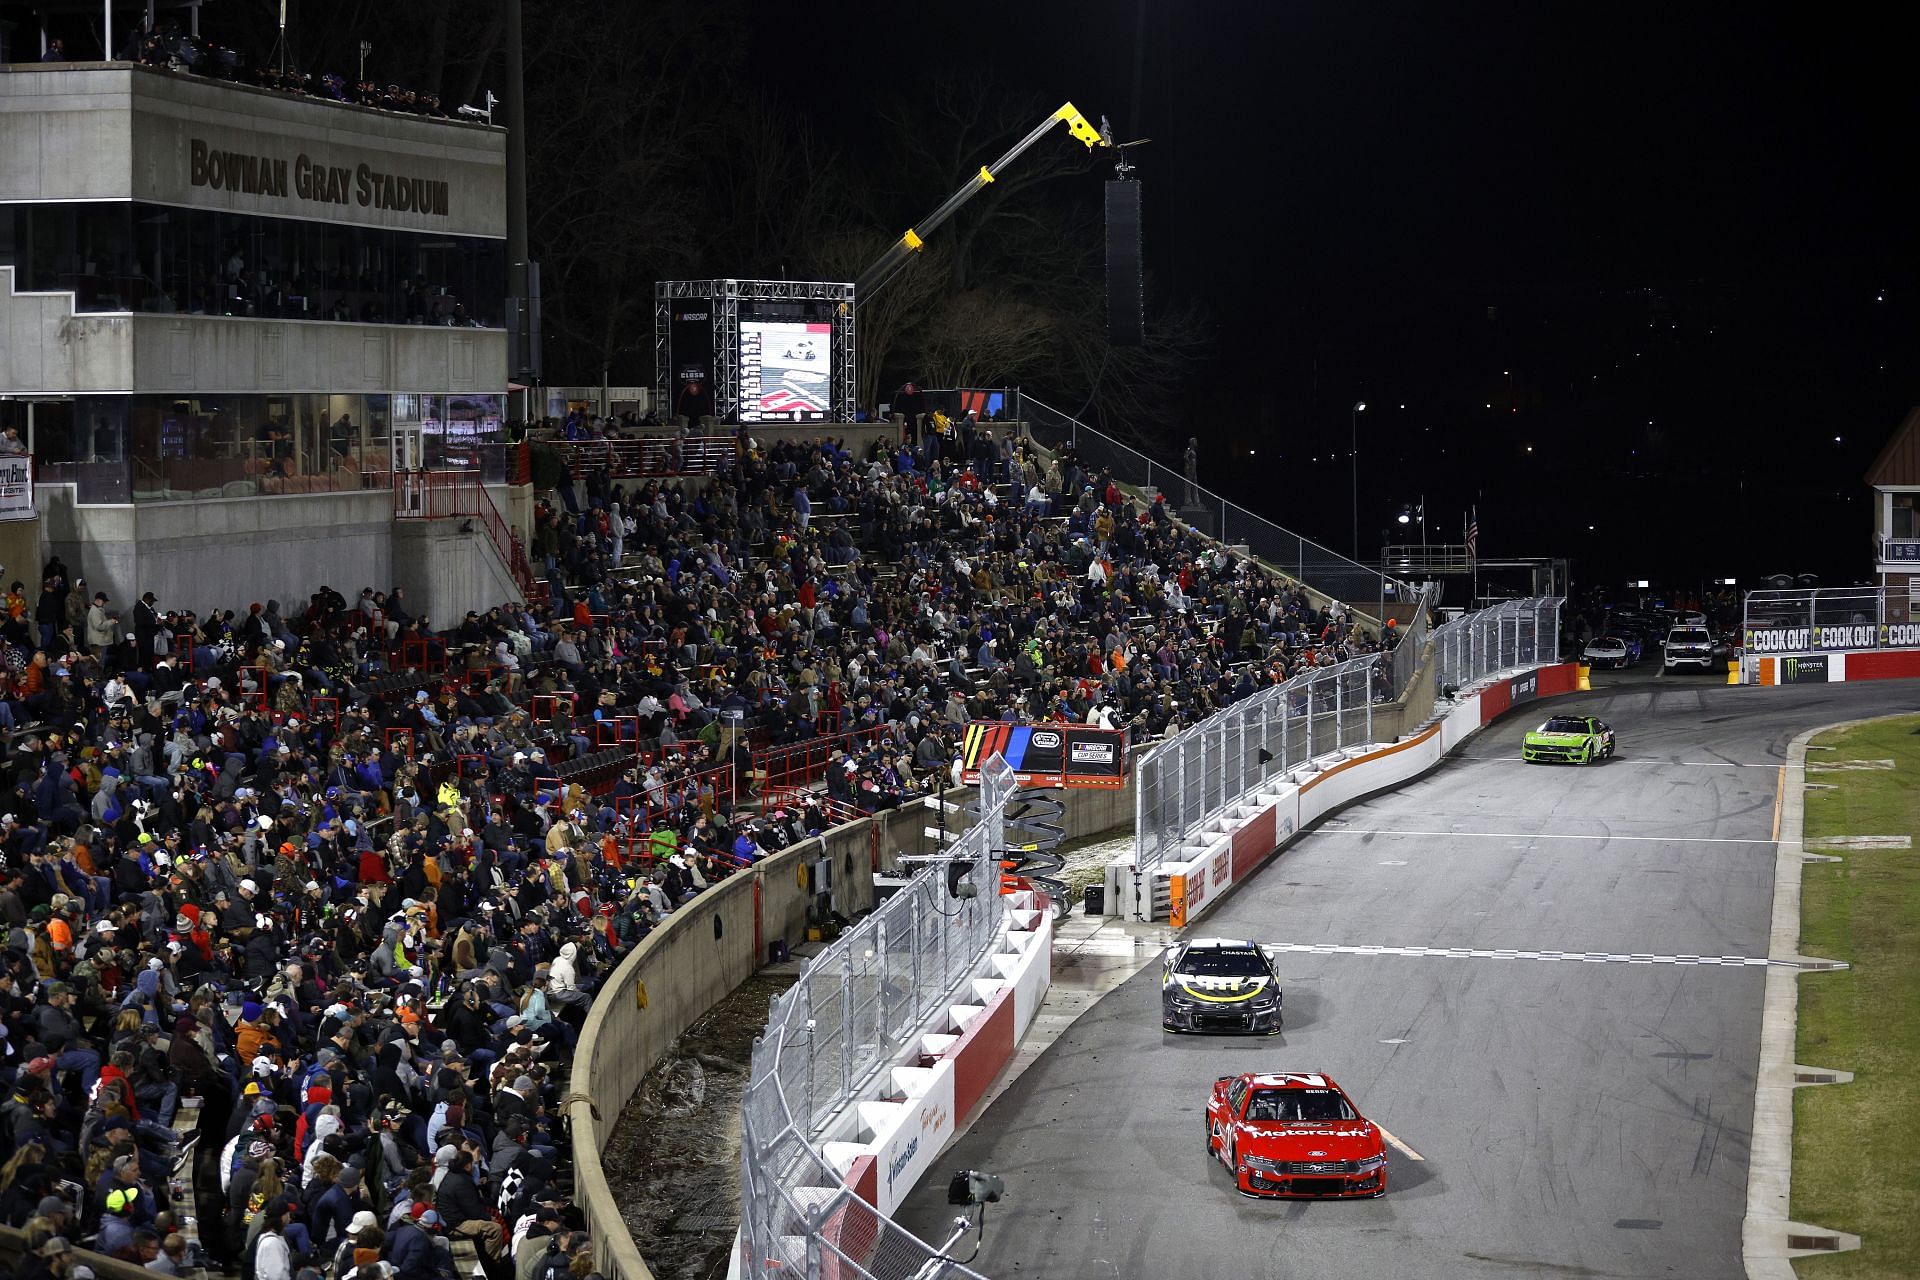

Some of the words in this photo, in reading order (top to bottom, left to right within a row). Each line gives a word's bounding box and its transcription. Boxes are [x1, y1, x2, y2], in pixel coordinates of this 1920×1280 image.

[295, 153, 352, 205] GRAY
[356, 163, 449, 216] STADIUM
[1753, 631, 1787, 651] COOK
[1787, 628, 1810, 649] OUT
[1821, 627, 1854, 648] COOK
[1854, 626, 1876, 646] OUT
[1252, 1129, 1368, 1138] Motorcraft
[1254, 1170, 1263, 1178] 21
